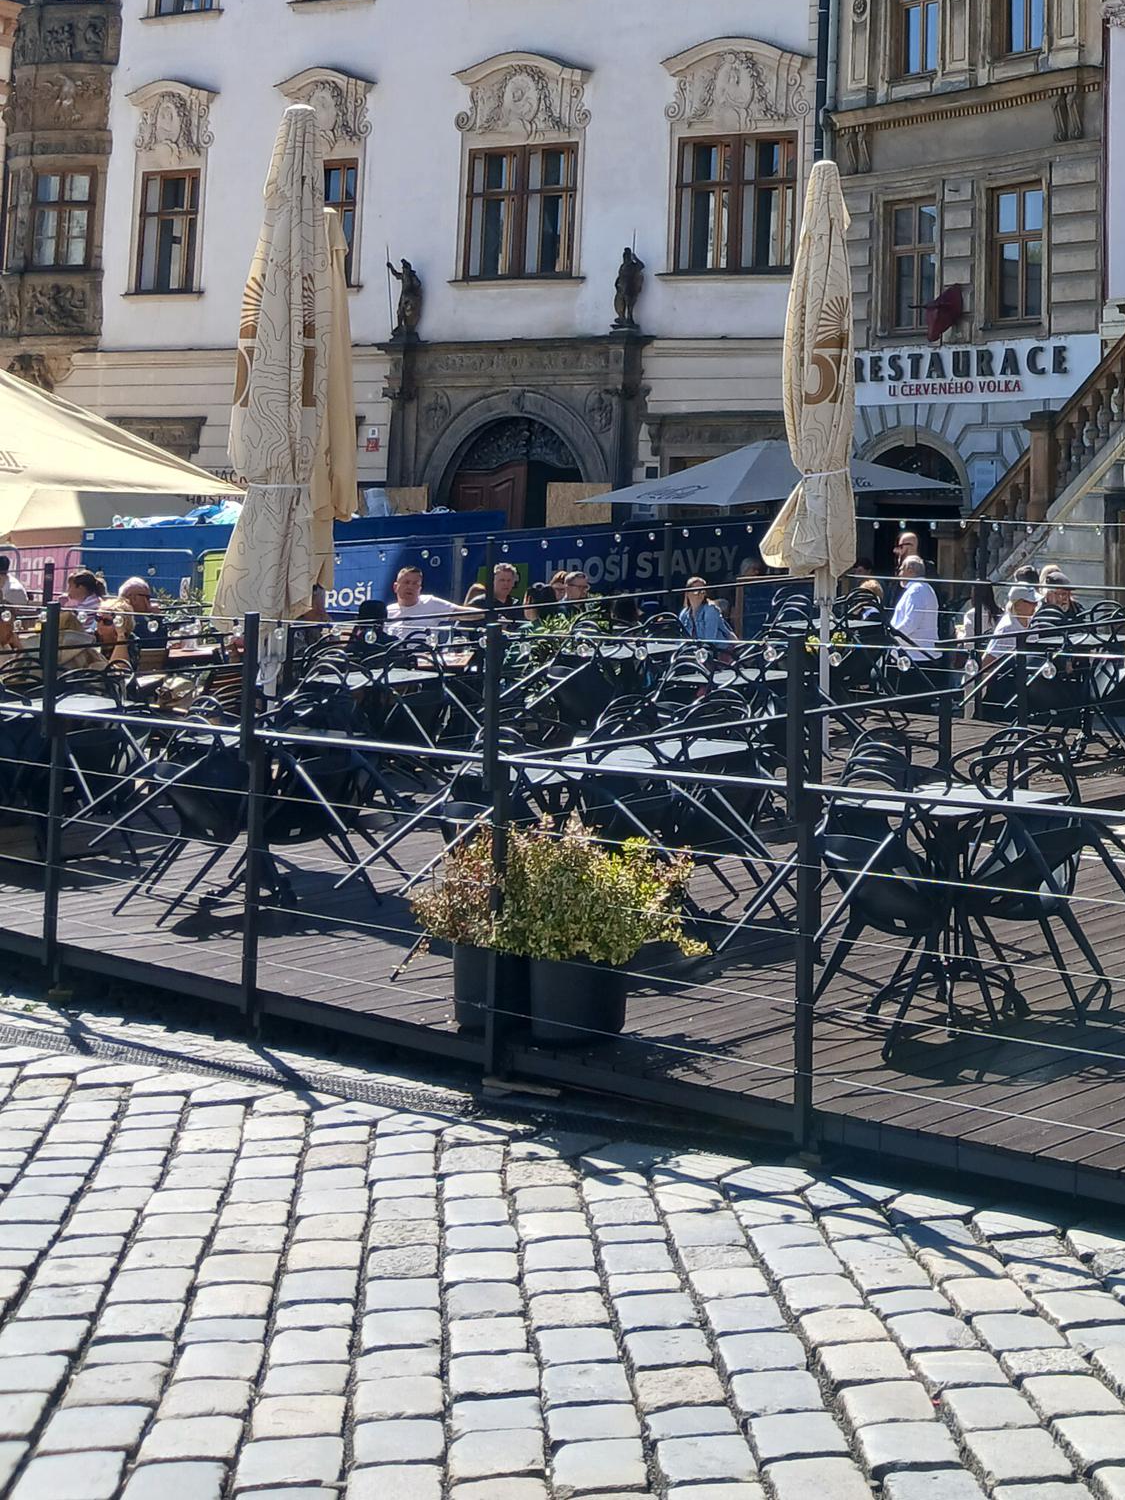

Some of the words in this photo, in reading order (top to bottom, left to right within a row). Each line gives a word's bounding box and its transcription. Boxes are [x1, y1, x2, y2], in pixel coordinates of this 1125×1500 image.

[855, 345, 1068, 383] RESTAURACE
[888, 385, 897, 397] U
[900, 376, 974, 397] ČERVENÉHO
[978, 379, 1023, 394] VOLKA
[635, 545, 739, 578] STAVBY
[324, 581, 373, 608] ROŠÍ
